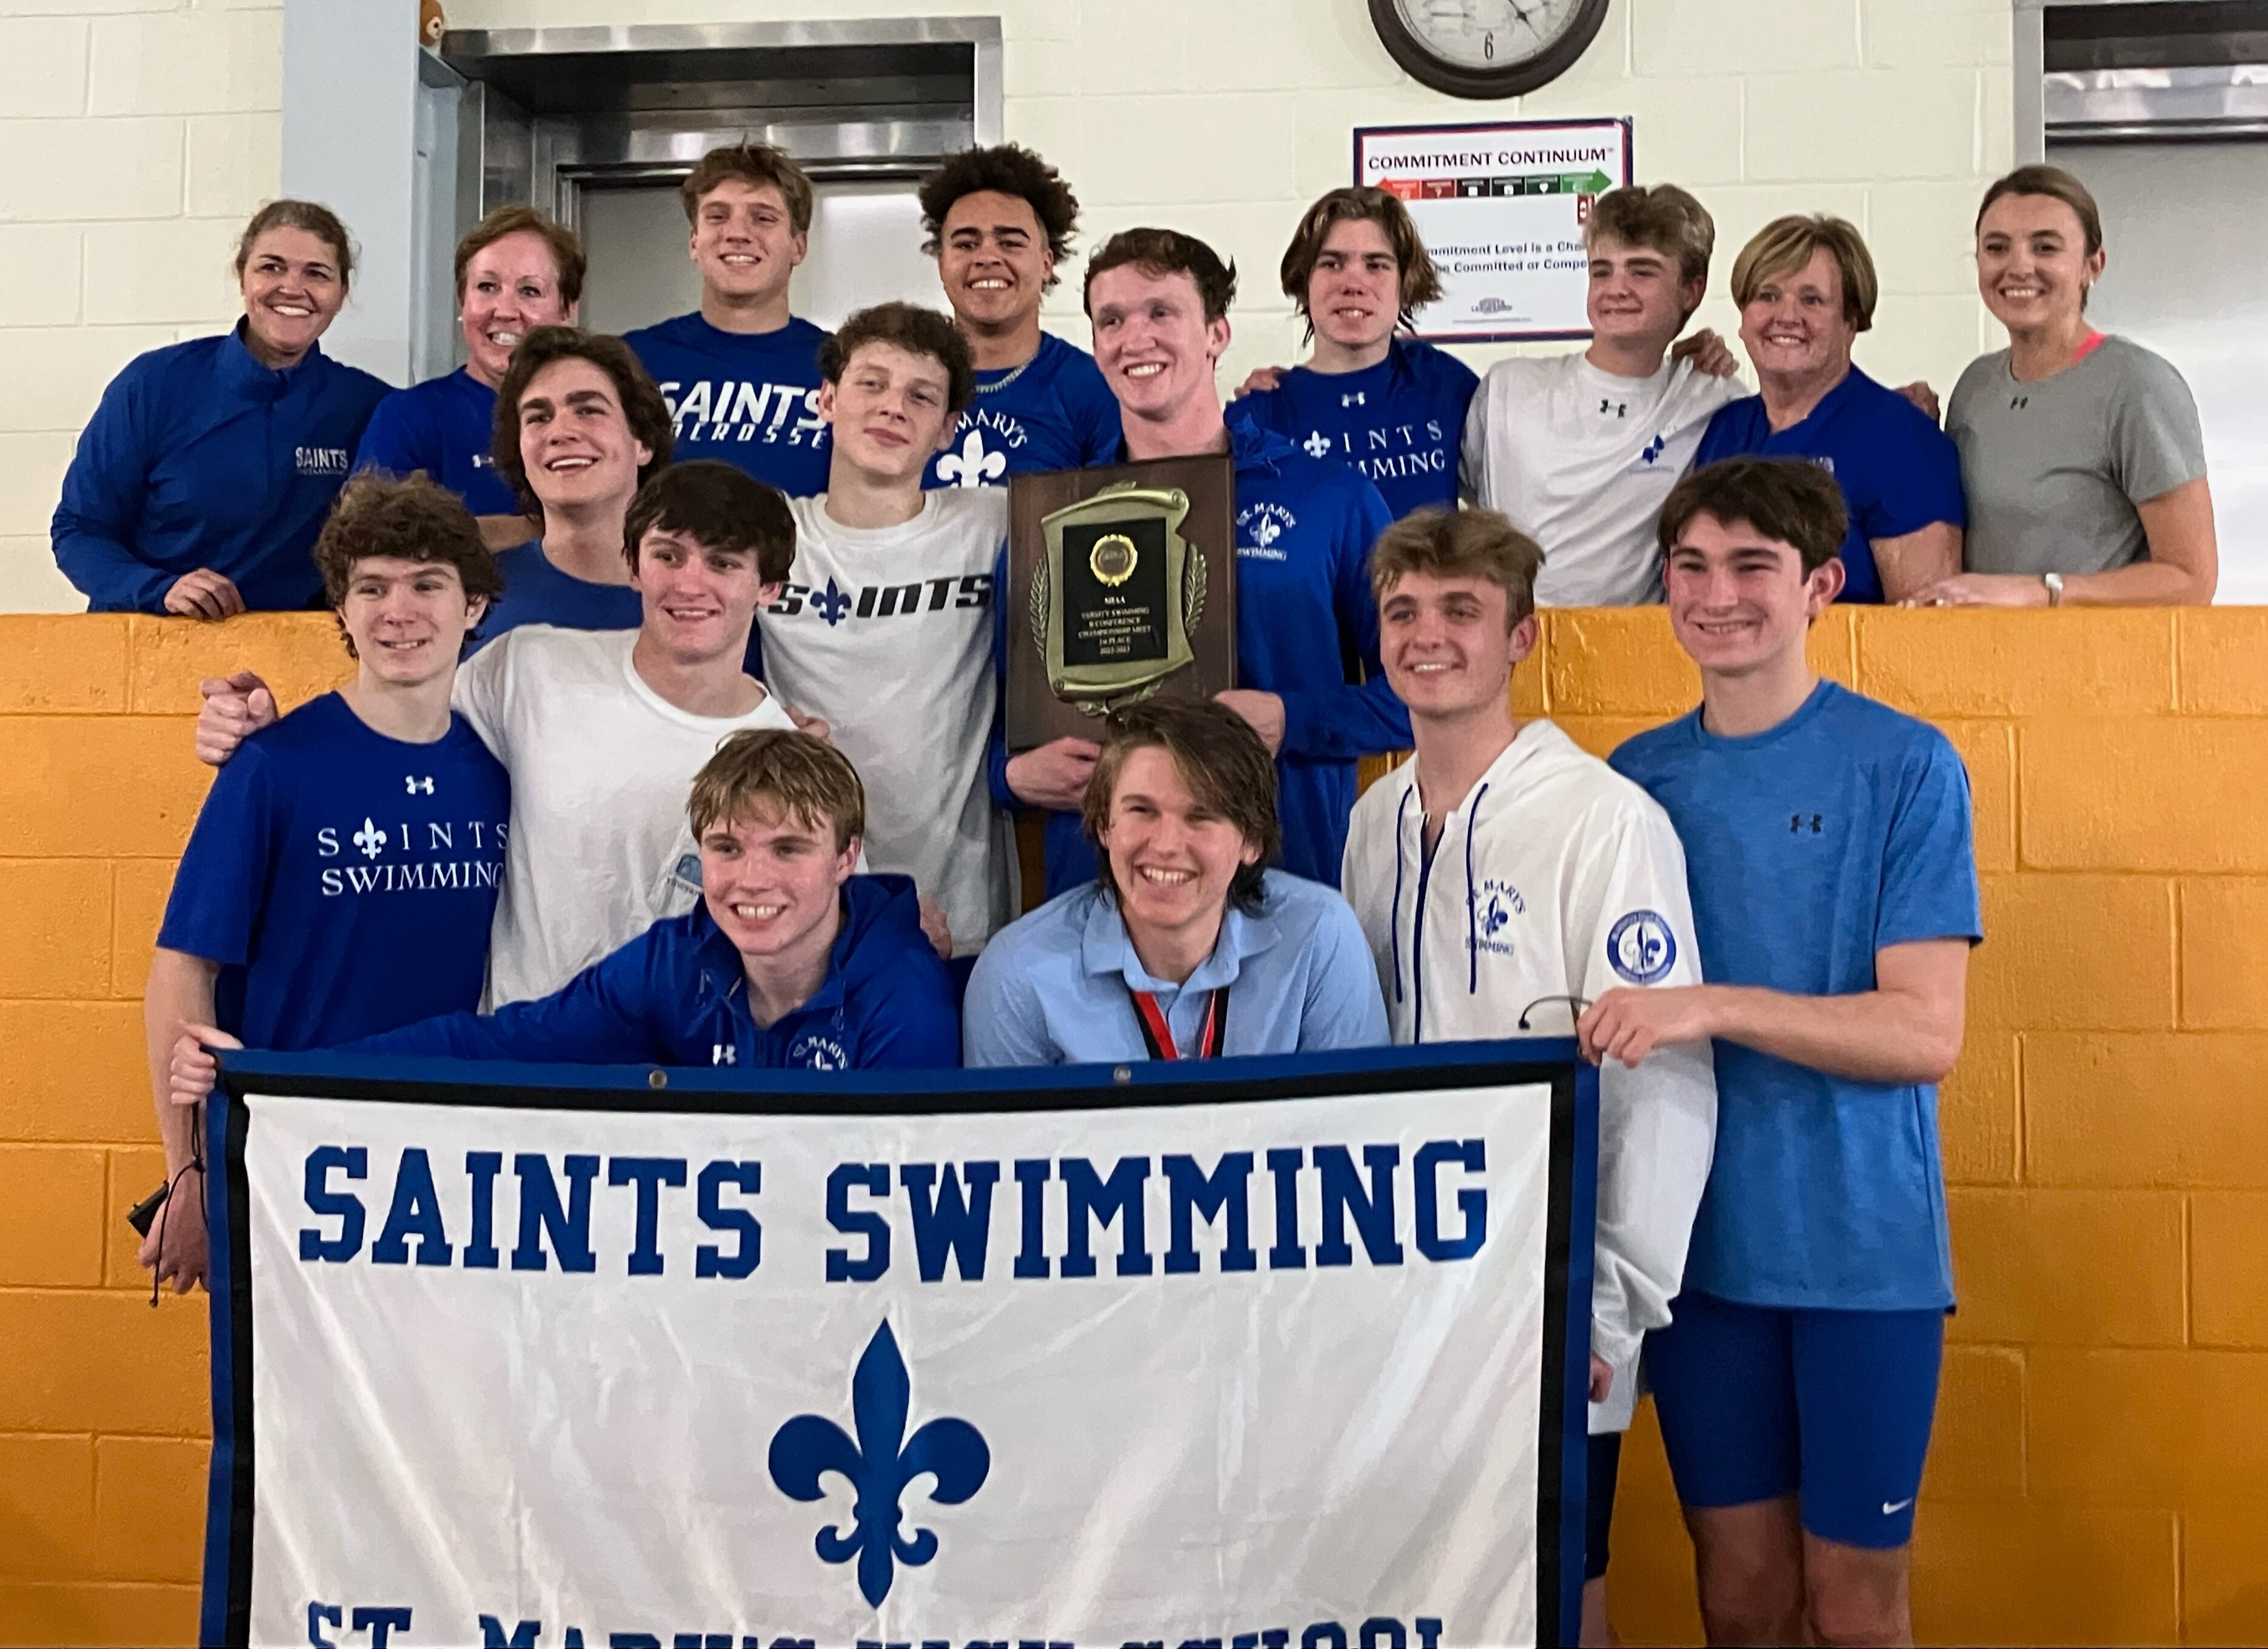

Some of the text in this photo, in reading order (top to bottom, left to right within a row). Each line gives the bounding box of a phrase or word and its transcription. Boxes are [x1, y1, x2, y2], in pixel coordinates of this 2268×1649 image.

[1483, 32, 1494, 60] 6
[1368, 152, 1493, 170] COMMITMENT
[1427, 244, 1491, 256] mmitment
[1495, 242, 1527, 254] Level
[1454, 261, 1523, 273] Committed
[659, 381, 827, 430] SAINTS
[670, 422, 828, 449] ACROSSE
[295, 446, 349, 469] SAINTS
[299, 1137, 1488, 1284] SAINTS SWIMMING
